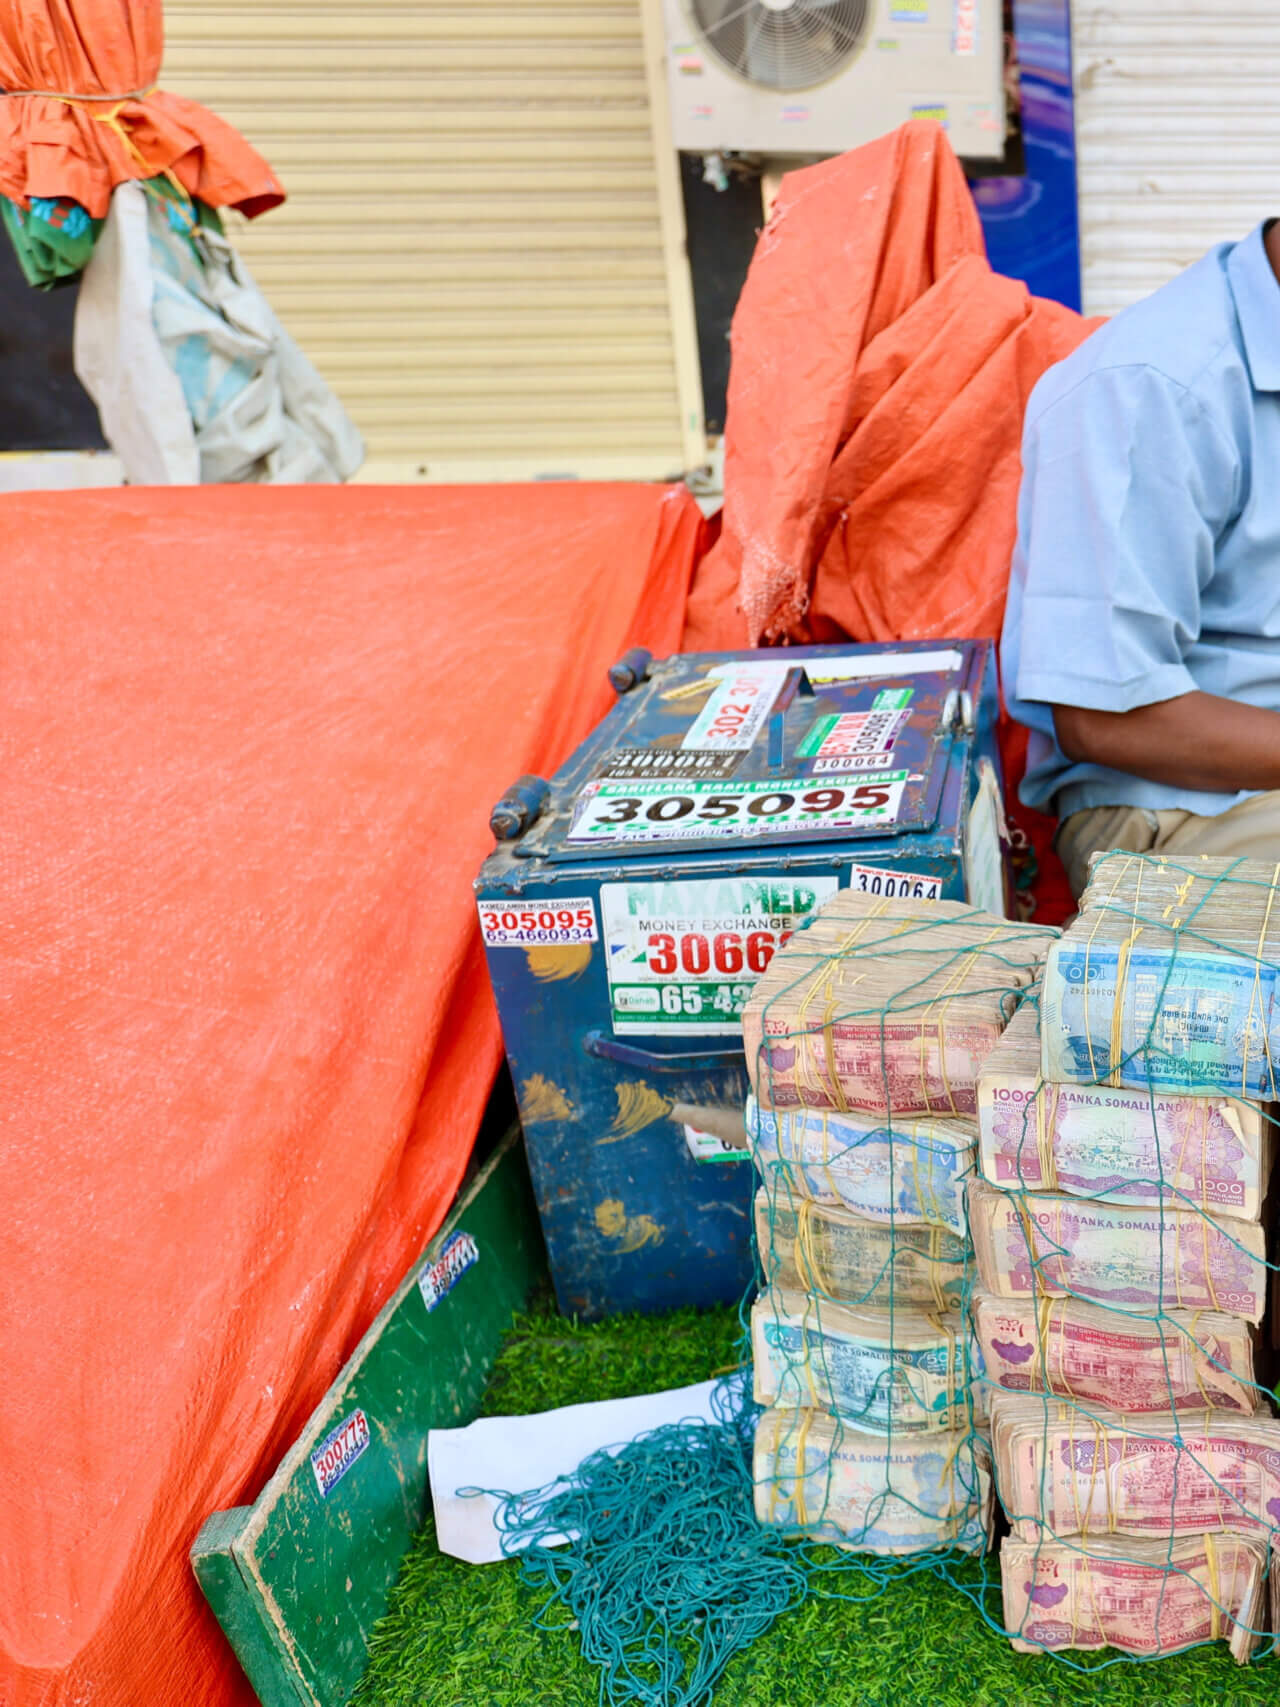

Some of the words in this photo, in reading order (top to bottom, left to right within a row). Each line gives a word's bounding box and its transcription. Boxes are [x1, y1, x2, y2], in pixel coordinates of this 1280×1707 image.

[816, 755, 890, 770] 300064
[595, 783, 893, 823] 305095
[858, 873, 938, 899] 300064
[482, 909, 594, 931] 305095
[638, 918, 696, 931] MONEY
[702, 917, 792, 931] EXCHANGE
[486, 927, 593, 941] 65-4660934
[648, 931, 795, 975] 3066
[991, 1087, 1037, 1102] 1000
[1064, 1214, 1114, 1230] BAANKA
[1215, 1291, 1254, 1304] 000
[317, 1410, 367, 1481] 300775
[1125, 1443, 1176, 1454] BAANKA
[1033, 1630, 1073, 1641] 1000
